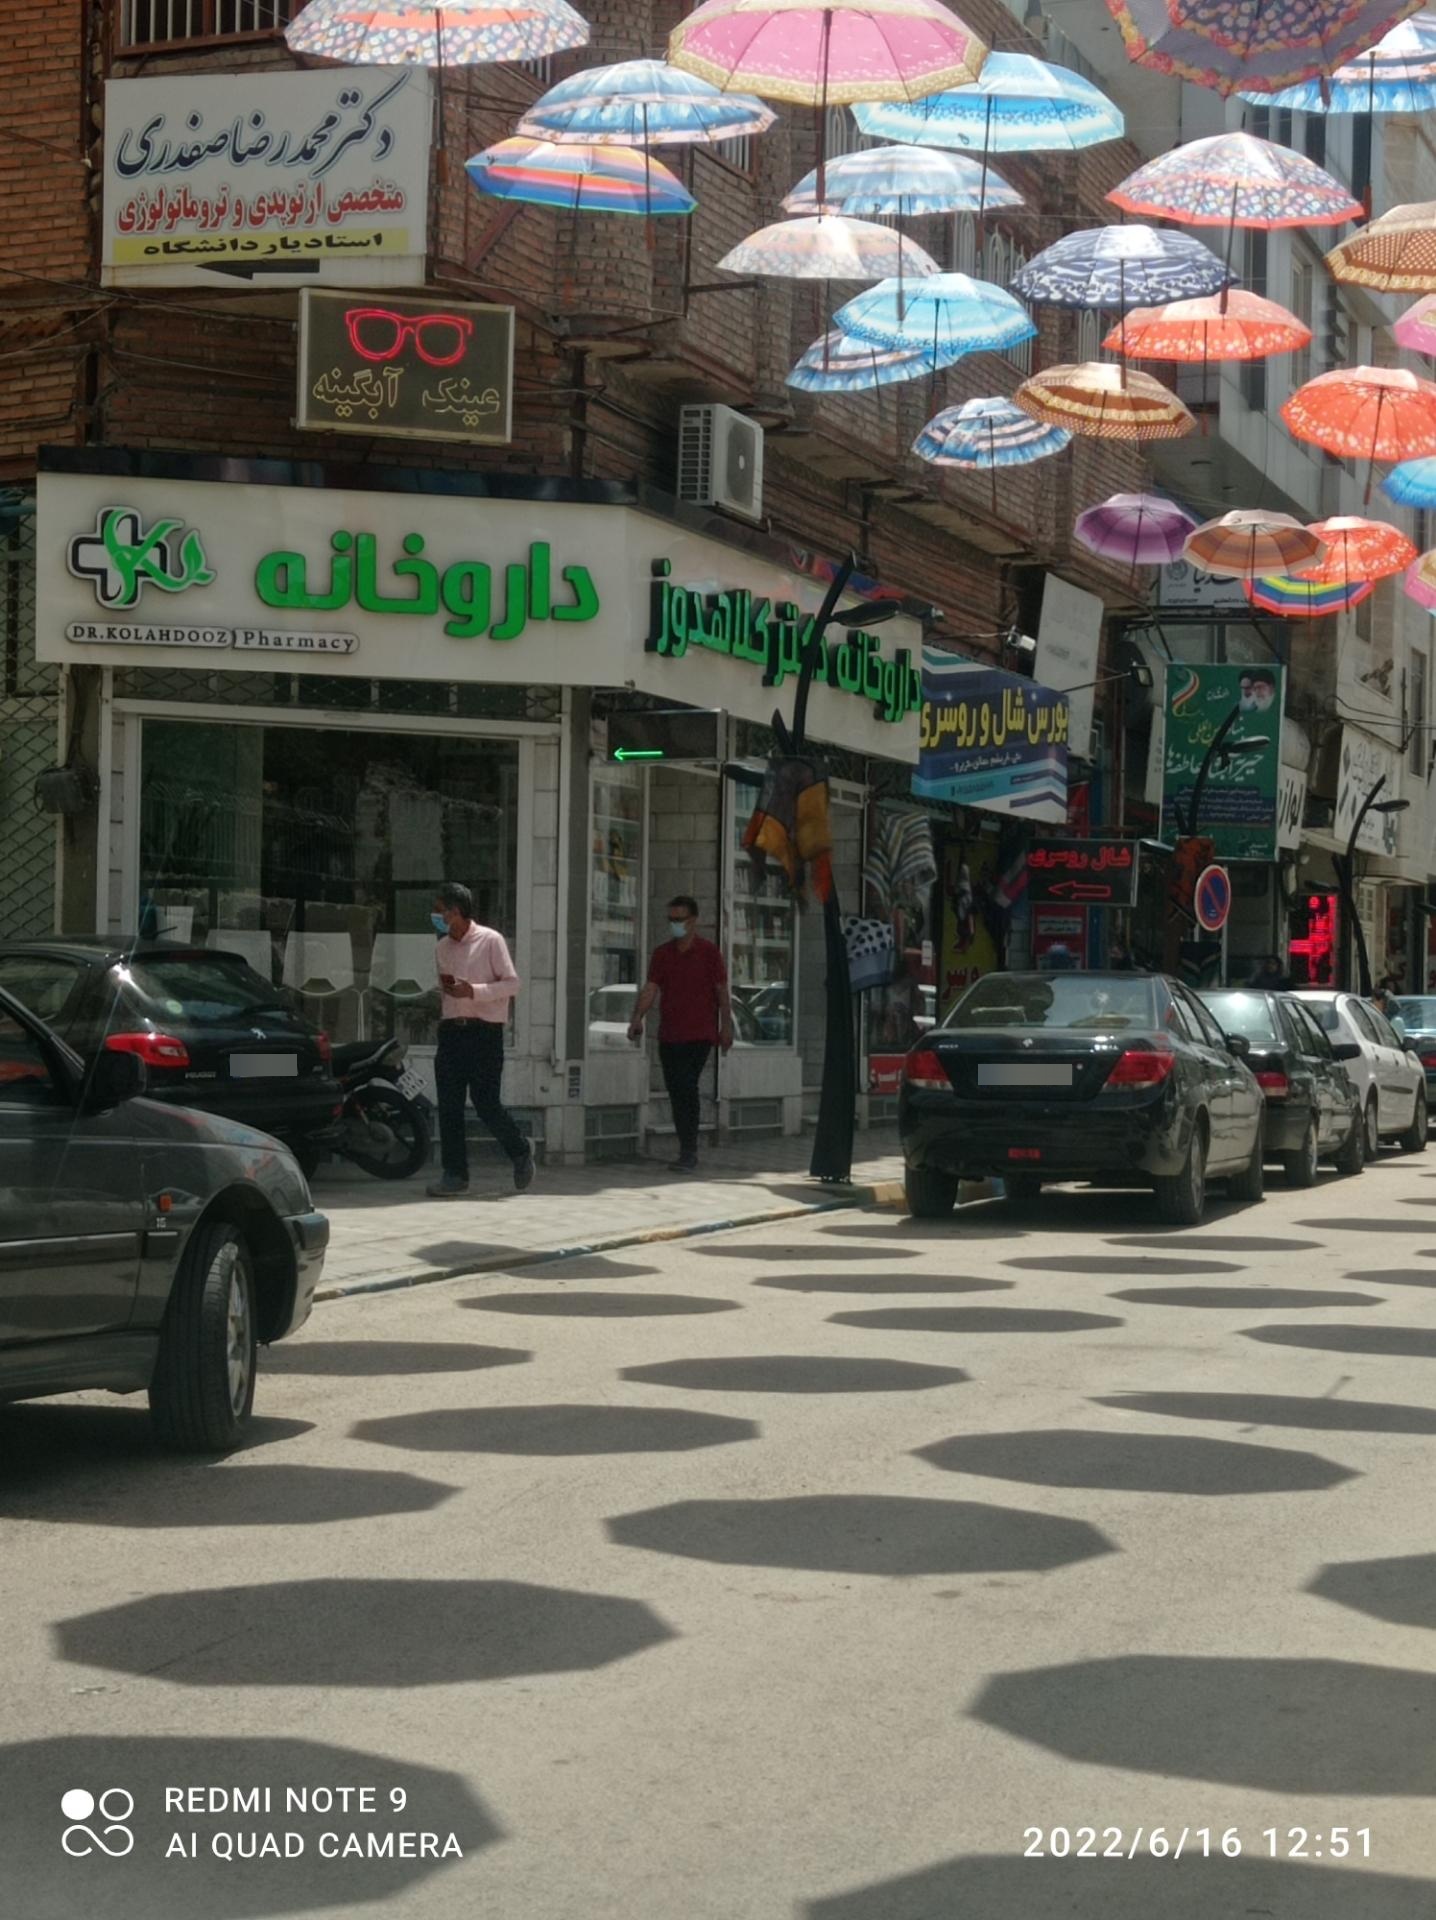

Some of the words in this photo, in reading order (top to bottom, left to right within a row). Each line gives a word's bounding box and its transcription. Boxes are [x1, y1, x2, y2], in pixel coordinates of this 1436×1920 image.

[115, 113, 231, 177] صفدری
[311, 70, 410, 177] دکتر
[117, 186, 228, 232] تروماتولوژی
[231, 197, 245, 228] و
[247, 182, 323, 227] ارتوپدی
[327, 178, 405, 223] متخصص
[262, 232, 383, 254] استادیار
[312, 366, 405, 420] آبگینه
[422, 377, 501, 426] عینک
[256, 530, 600, 640] داروخانه
[650, 557, 775, 665] کلاهدوز
[72, 624, 229, 644] DR.KOLAHDOOZ
[243, 630, 355, 652] Pharmacy
[832, 629, 923, 723] داروخانه
[919, 701, 977, 749] روسری
[979, 702, 990, 748] و
[993, 686, 1026, 746] شال
[1027, 702, 1069, 745] بورس
[1090, 845, 1132, 872] شال
